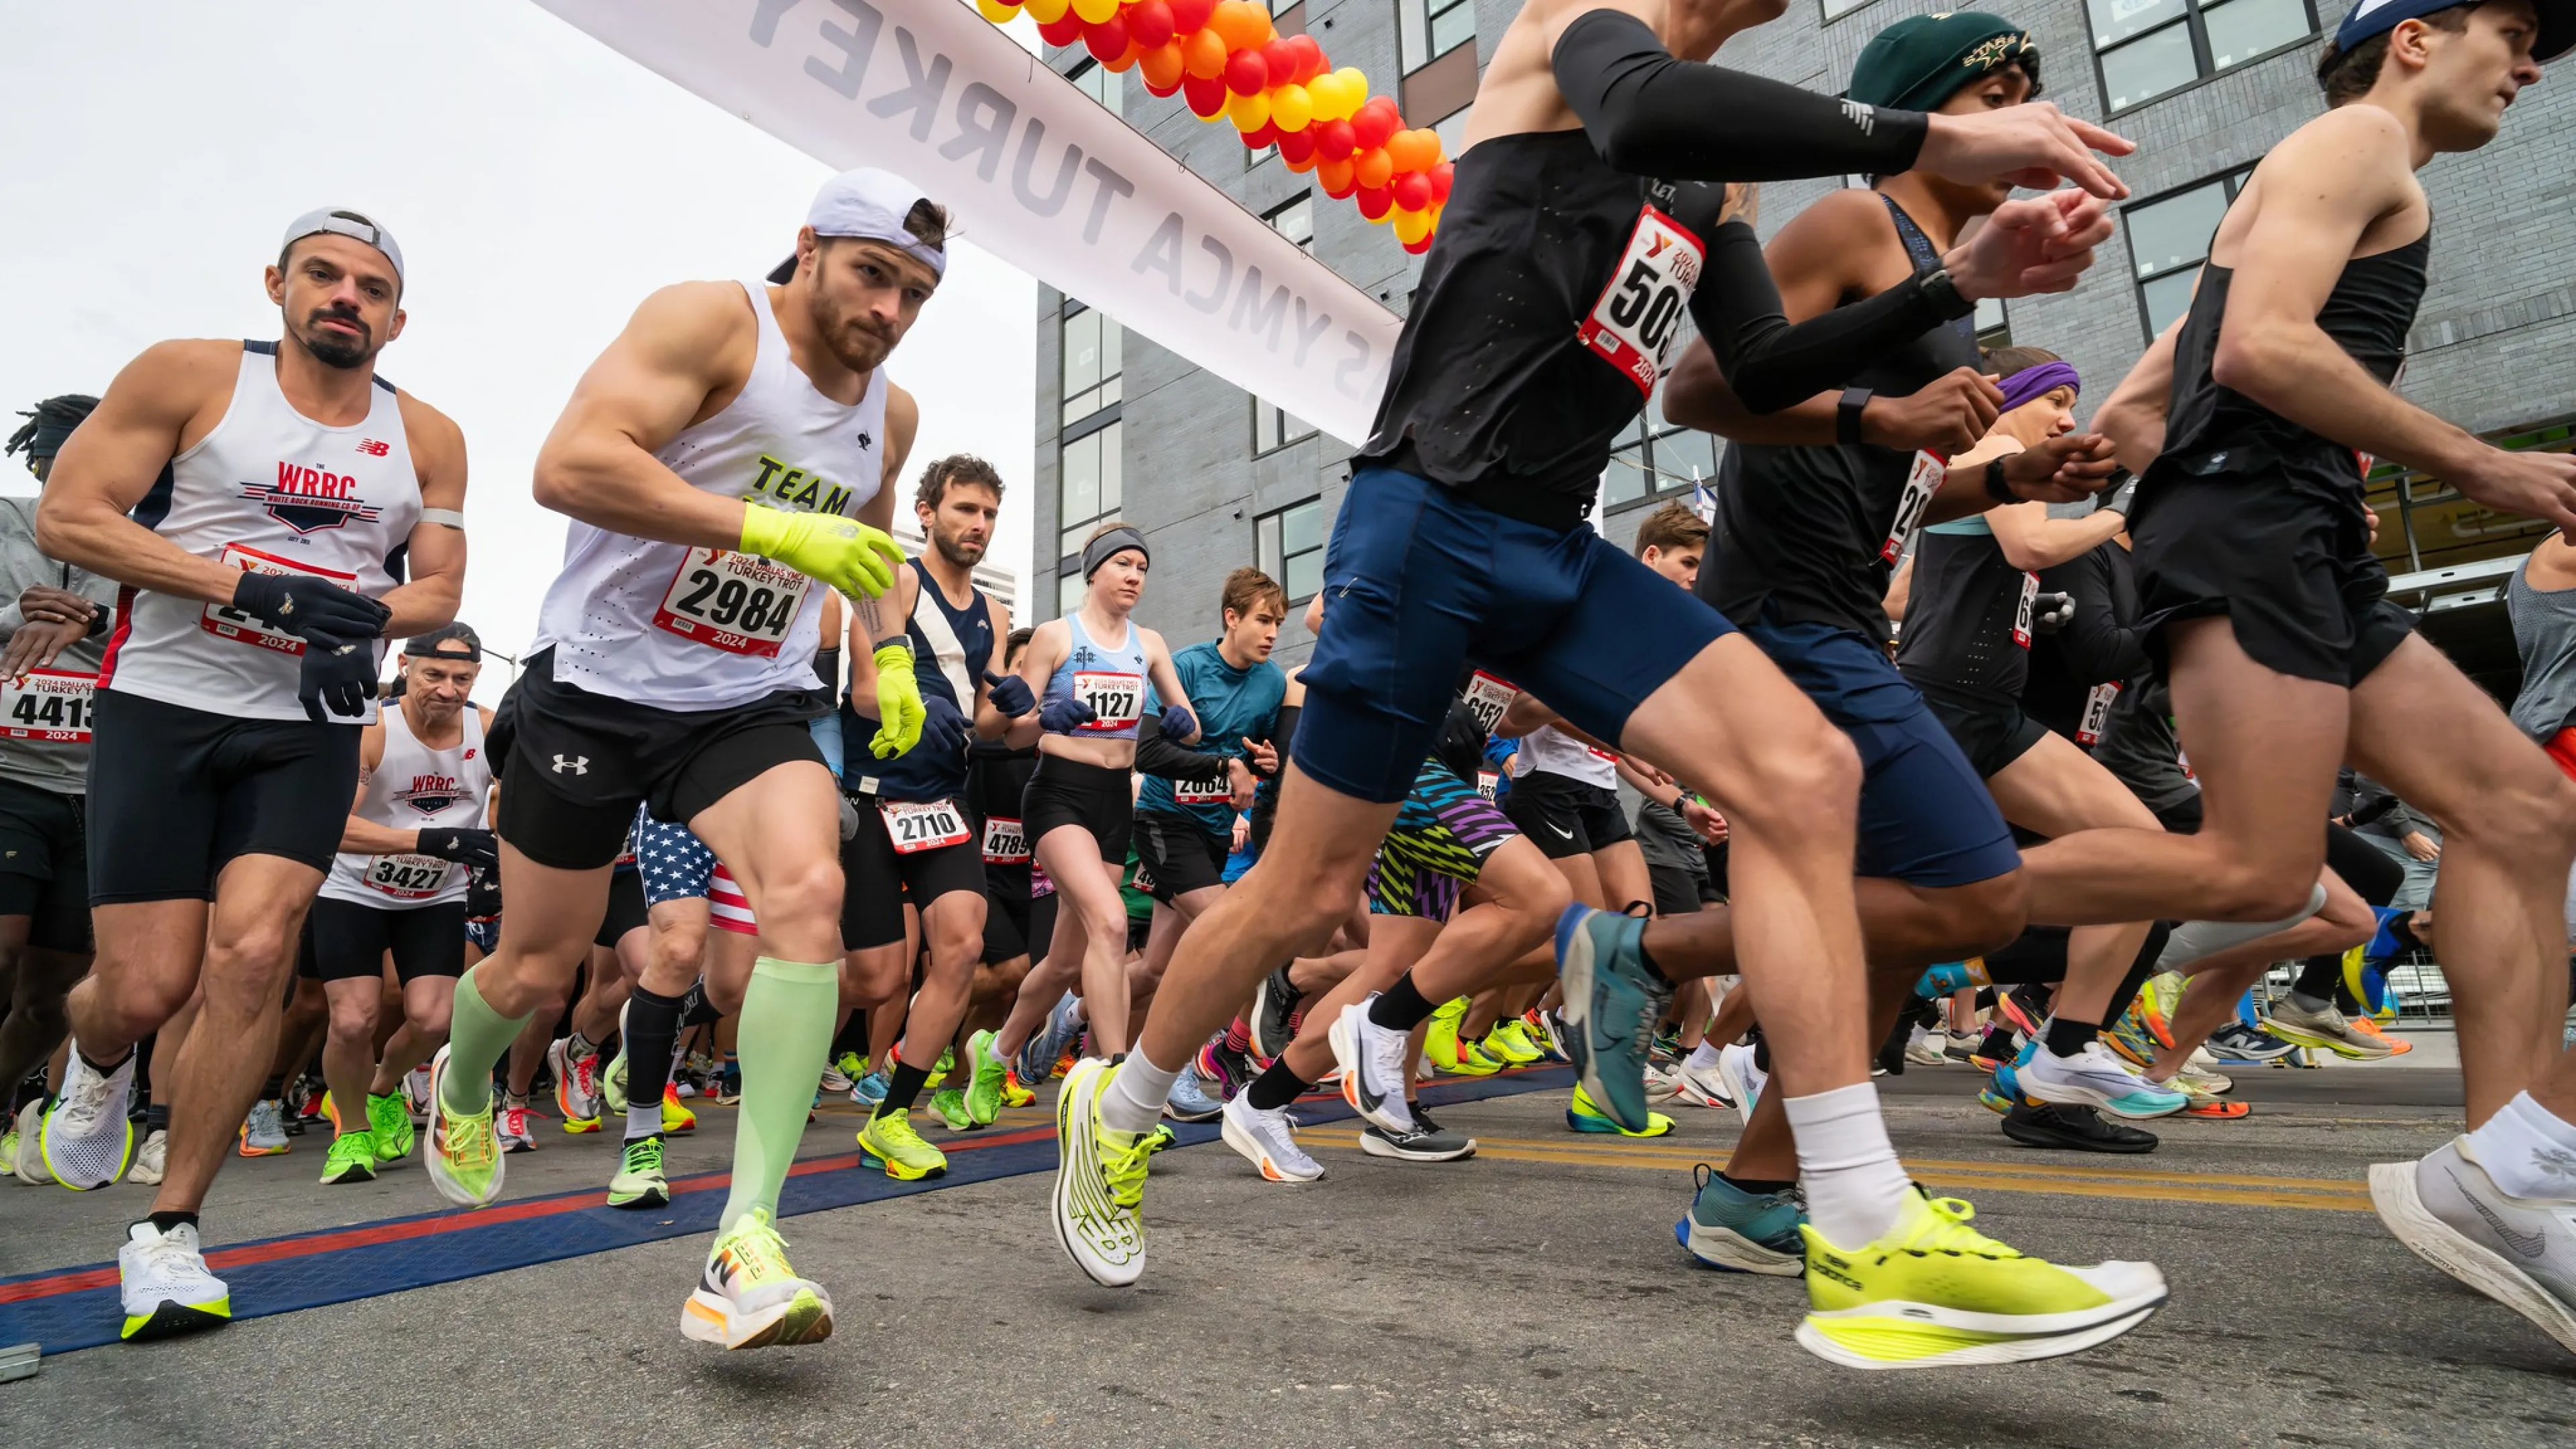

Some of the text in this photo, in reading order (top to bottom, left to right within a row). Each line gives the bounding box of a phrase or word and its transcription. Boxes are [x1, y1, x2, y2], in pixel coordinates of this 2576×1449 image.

[278, 461, 356, 500] WRRC
[753, 455, 852, 517] TEAM
[268, 495, 361, 512] WHITE ROCK RUNNING CO-OP
[726, 561, 804, 591] TURKEY TROT
[729, 553, 805, 582] 2024 DALLAS YMCA
[676, 569, 796, 637] 2984
[259, 635, 297, 652] 2024
[711, 631, 748, 649] 2024
[35, 684, 81, 695] TURKEY
[1085, 691, 1134, 718] 1127
[45, 730, 78, 741] 2024
[412, 775, 455, 793] WRRC
[896, 812, 957, 841] 2710
[926, 838, 946, 847] 2024
[987, 833, 1028, 855] 4789
[376, 861, 443, 889] 3427
[393, 889, 415, 897] 2024
